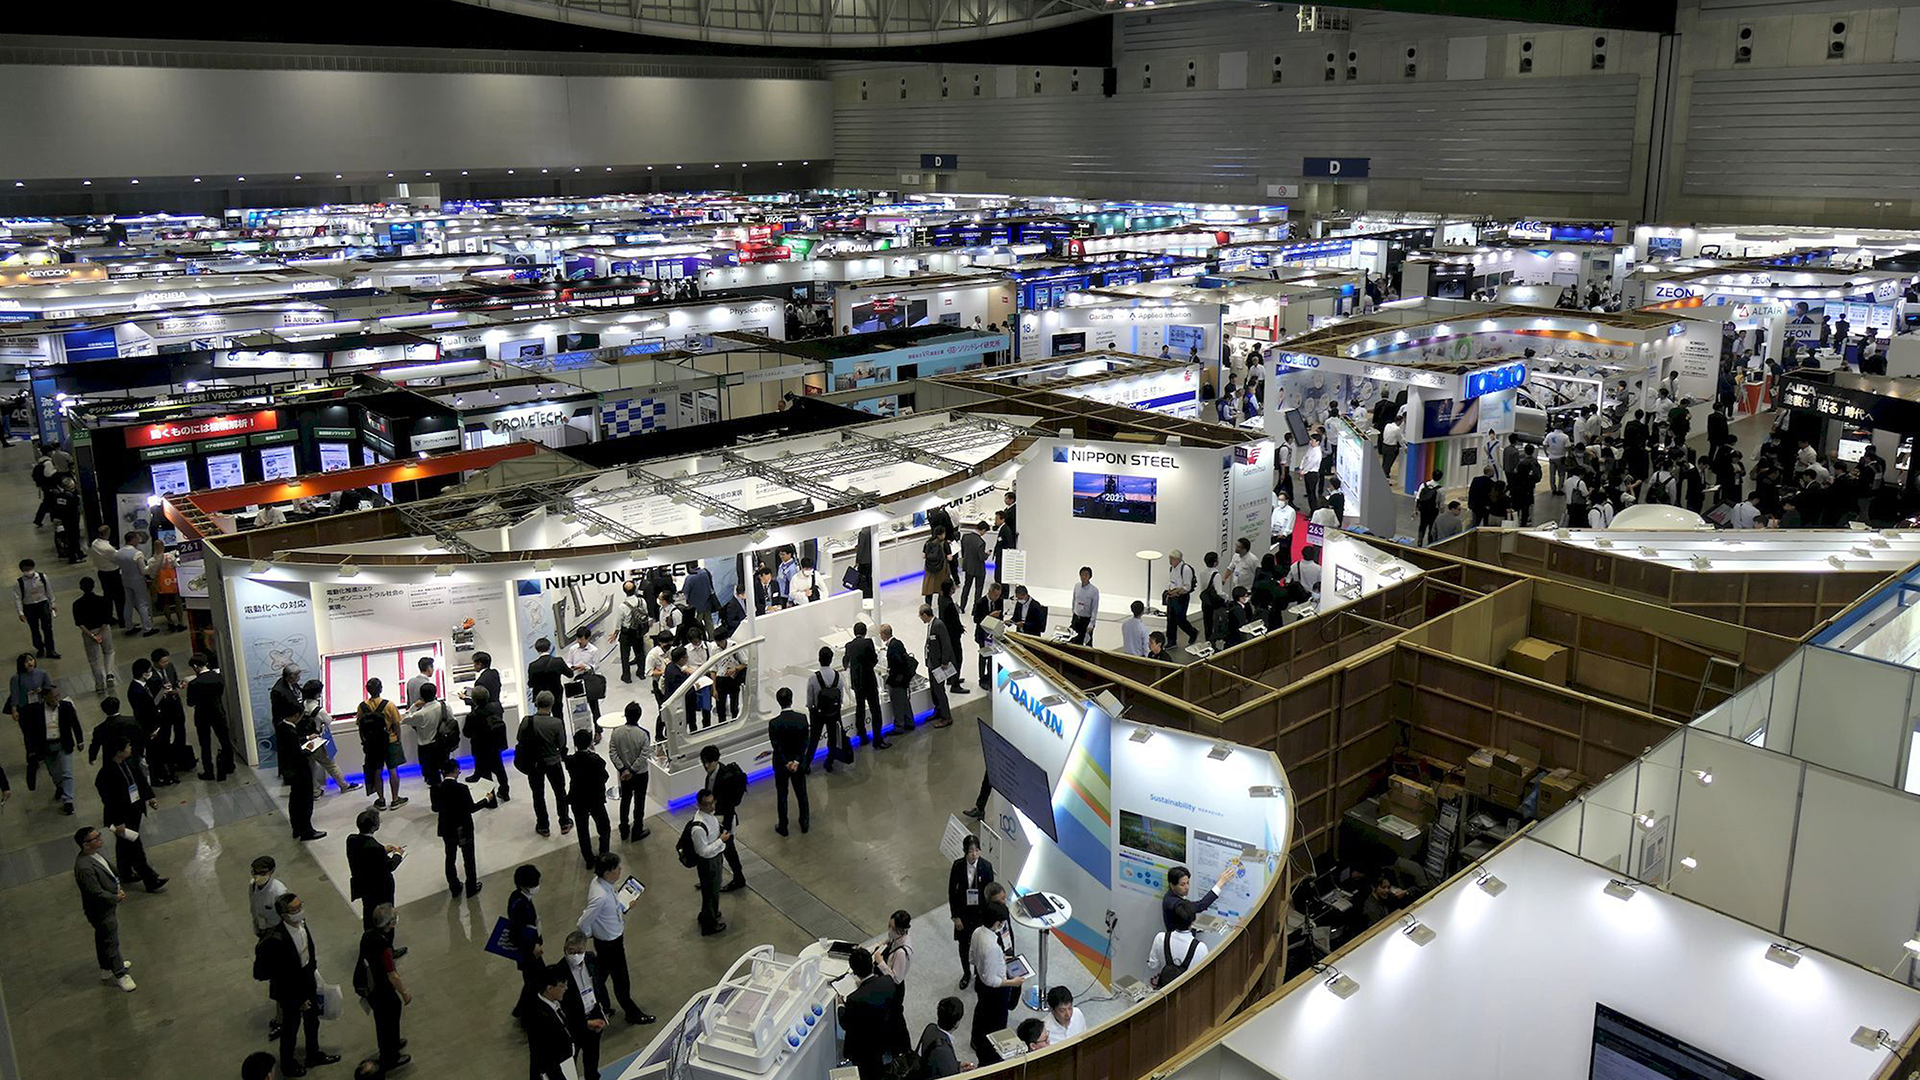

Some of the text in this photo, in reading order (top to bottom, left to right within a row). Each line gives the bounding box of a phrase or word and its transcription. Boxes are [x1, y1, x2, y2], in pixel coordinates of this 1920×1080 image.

[935, 156, 942, 166] D
[1329, 160, 1341, 174] D
[1515, 221, 1541, 231] AGC
[25, 268, 71, 277] KEYCOM
[292, 281, 332, 290] HORIBA
[1751, 276, 1771, 284] ZEON
[1656, 287, 1694, 298] ZEON
[1878, 284, 1896, 297] ZEON
[143, 292, 187, 301] HORIBA
[729, 304, 777, 316] Physical test
[1751, 306, 1782, 315] ALTAIR
[1138, 312, 1163, 321] Applied
[1022, 324, 1031, 333] 18
[1783, 329, 1812, 338] ZEON
[464, 335, 482, 344] Test
[270, 375, 354, 395] FORUM8
[495, 411, 563, 432] PROMETECH
[1071, 451, 1180, 469] NIPPON STEEL
[1220, 471, 1230, 557] NIPPON STEEL
[1308, 525, 1324, 536] 263
[180, 542, 199, 553] 261
[545, 570, 626, 590] NIPPON
[327, 589, 404, 603] カーボンニュートラル社会の
[244, 599, 307, 614] 電動化への対応
[1009, 679, 1063, 739] DAIKIN
[1150, 793, 1196, 812] Sustainability
